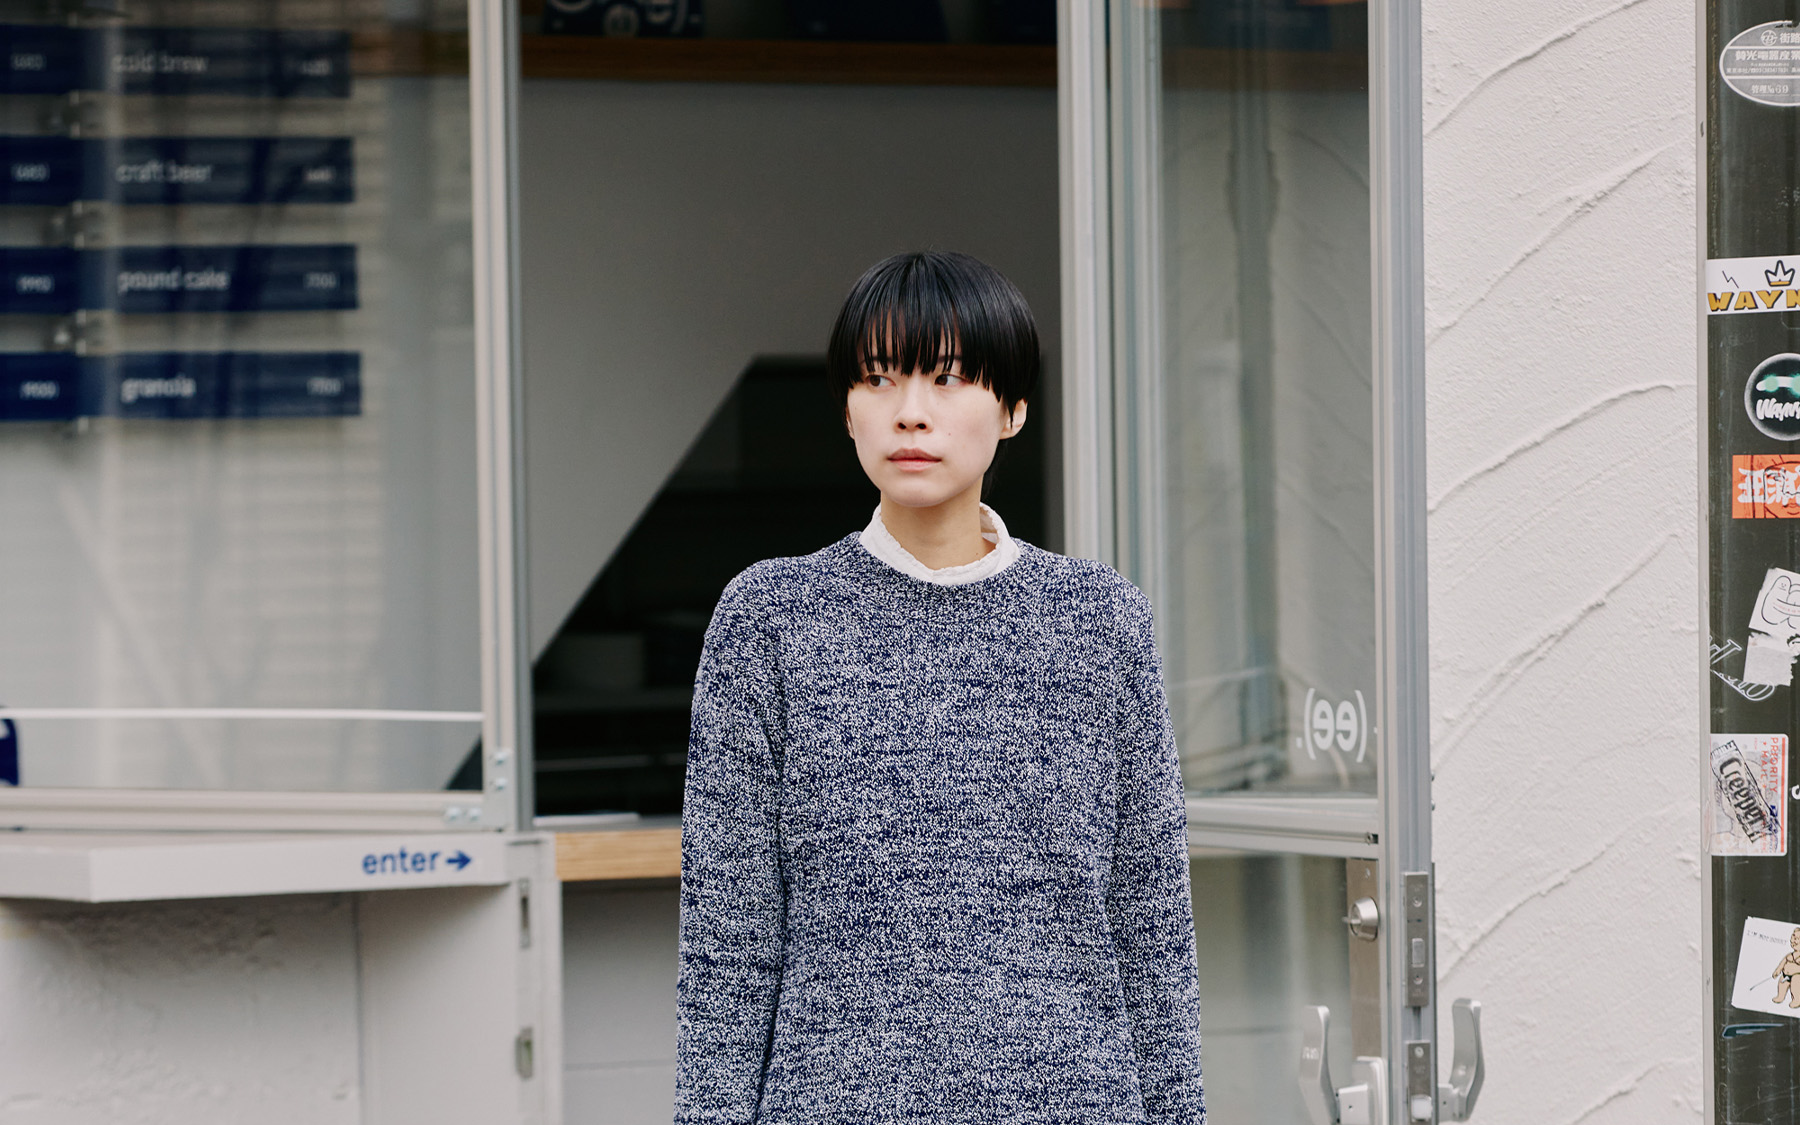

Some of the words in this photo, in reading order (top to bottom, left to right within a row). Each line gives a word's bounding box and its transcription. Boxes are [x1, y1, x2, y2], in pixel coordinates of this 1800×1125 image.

[118, 268, 179, 294] pound
[184, 268, 230, 290] cake
[121, 375, 196, 402] granola
[1760, 750, 1768, 780] MAIL
[1769, 737, 1779, 793] PRIORITY
[362, 846, 441, 876] enter
